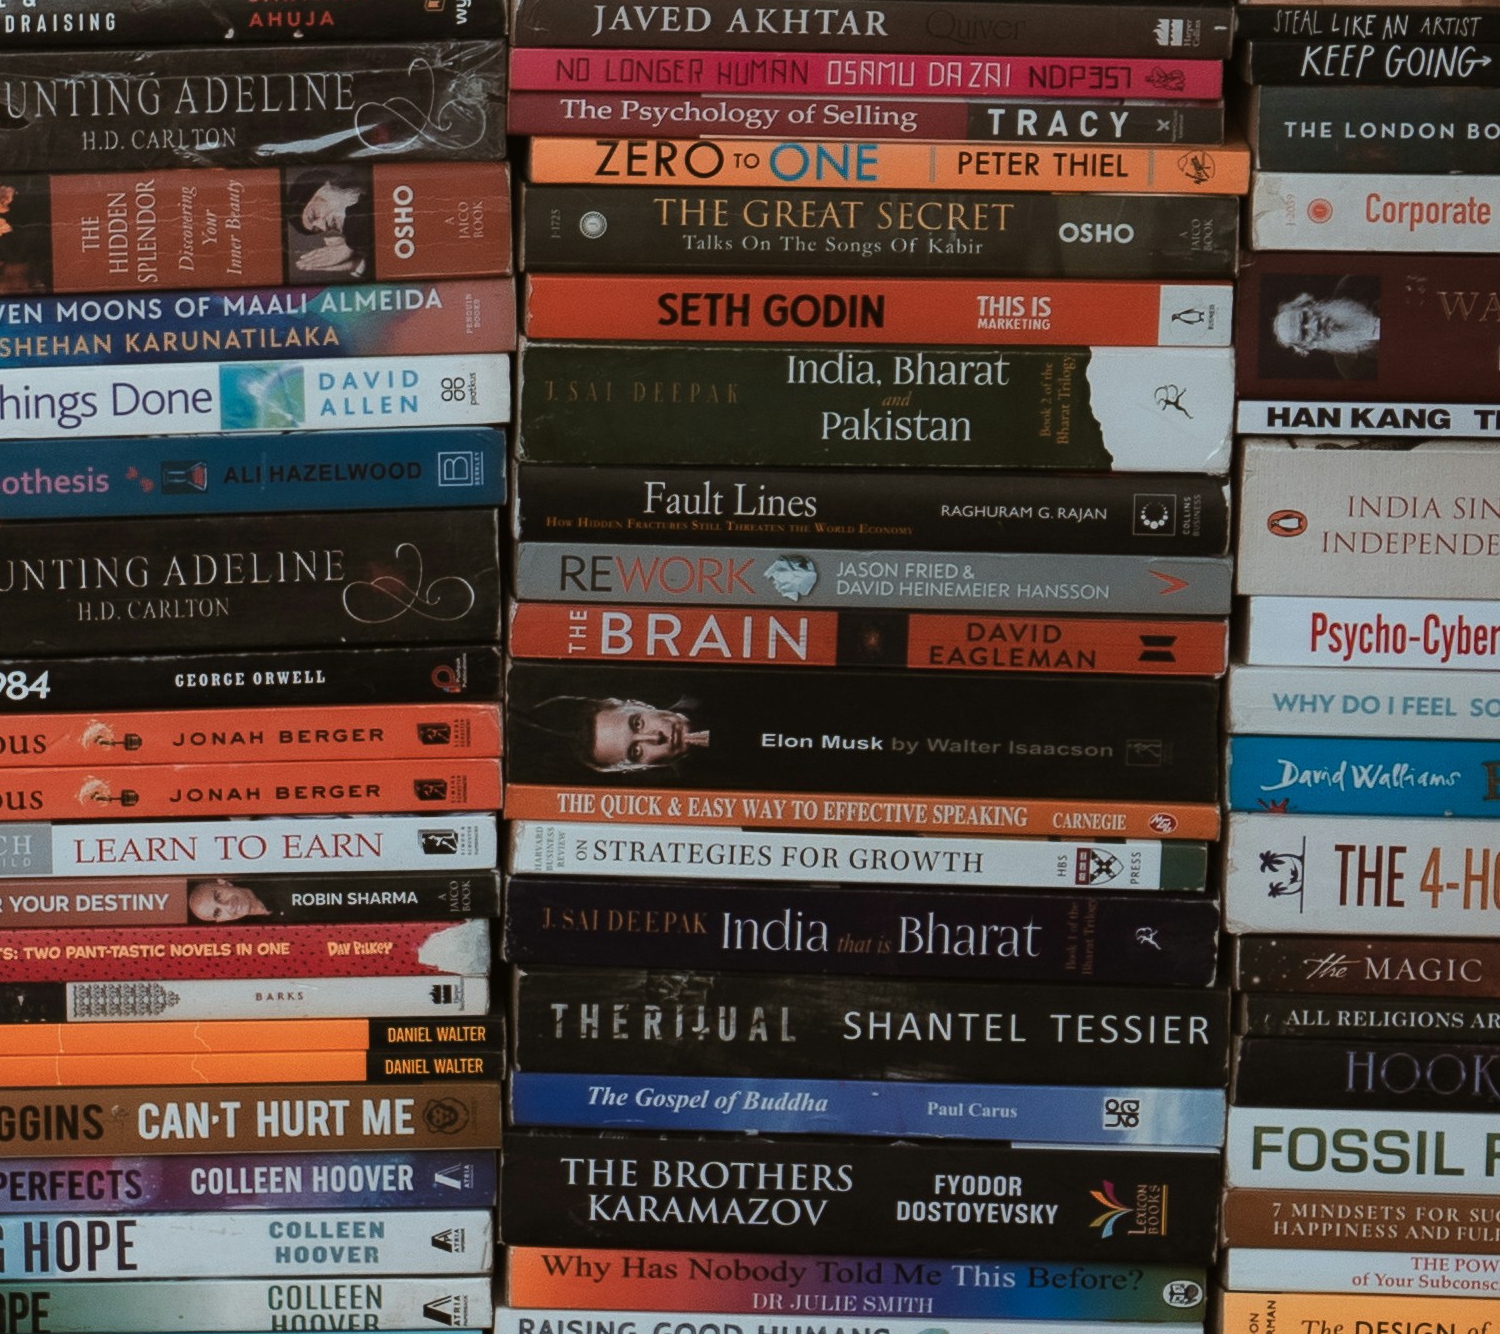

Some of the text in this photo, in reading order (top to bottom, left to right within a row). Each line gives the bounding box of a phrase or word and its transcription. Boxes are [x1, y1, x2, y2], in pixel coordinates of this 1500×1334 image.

[659, 293, 884, 329] SETH GODIN
[109, 381, 214, 416] Done
[844, 1010, 1209, 1047] SHANTEL TESSIER
